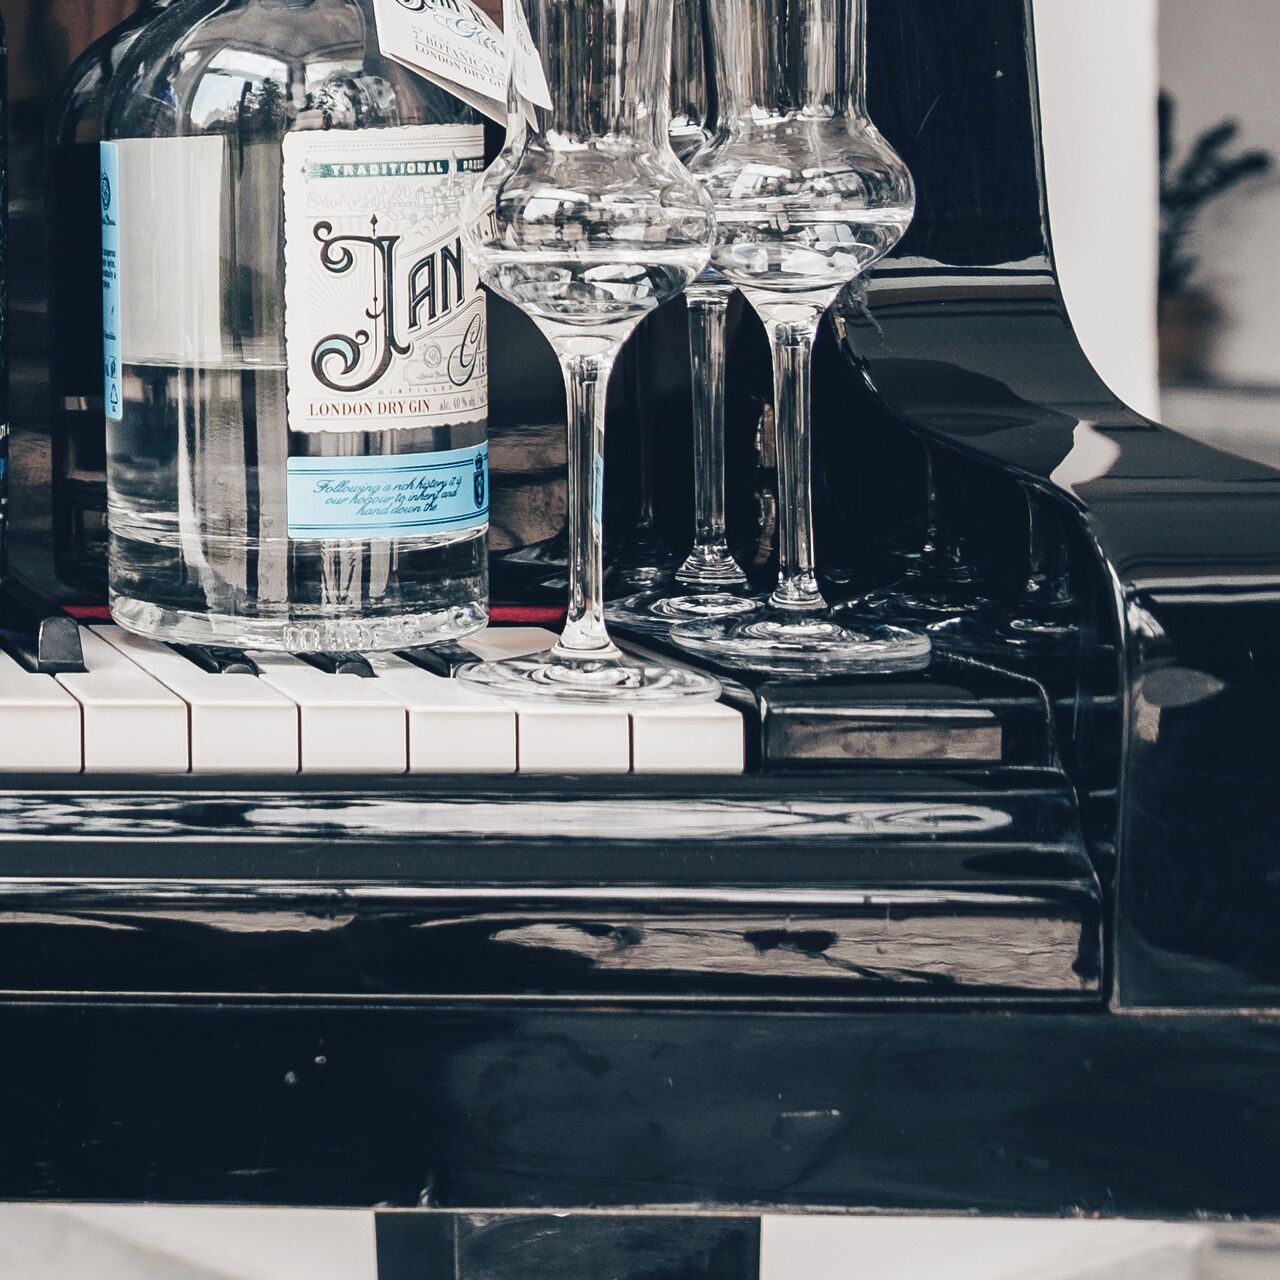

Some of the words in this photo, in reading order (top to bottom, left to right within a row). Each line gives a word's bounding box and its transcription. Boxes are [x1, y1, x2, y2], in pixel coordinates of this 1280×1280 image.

[415, 43, 460, 70] LONDON
[463, 66, 485, 81] DRY
[330, 161, 444, 177] TRADITIONAL
[309, 402, 372, 417] LONDON
[377, 400, 406, 415] DRY
[408, 398, 431, 413] GIN
[313, 479, 381, 495] Following
[393, 477, 415, 492] rich
[415, 476, 447, 492] history
[324, 496, 347, 505] our
[441, 489, 458, 499] and
[355, 503, 391, 516] hand
[391, 503, 421, 515] down
[423, 501, 438, 512] the
